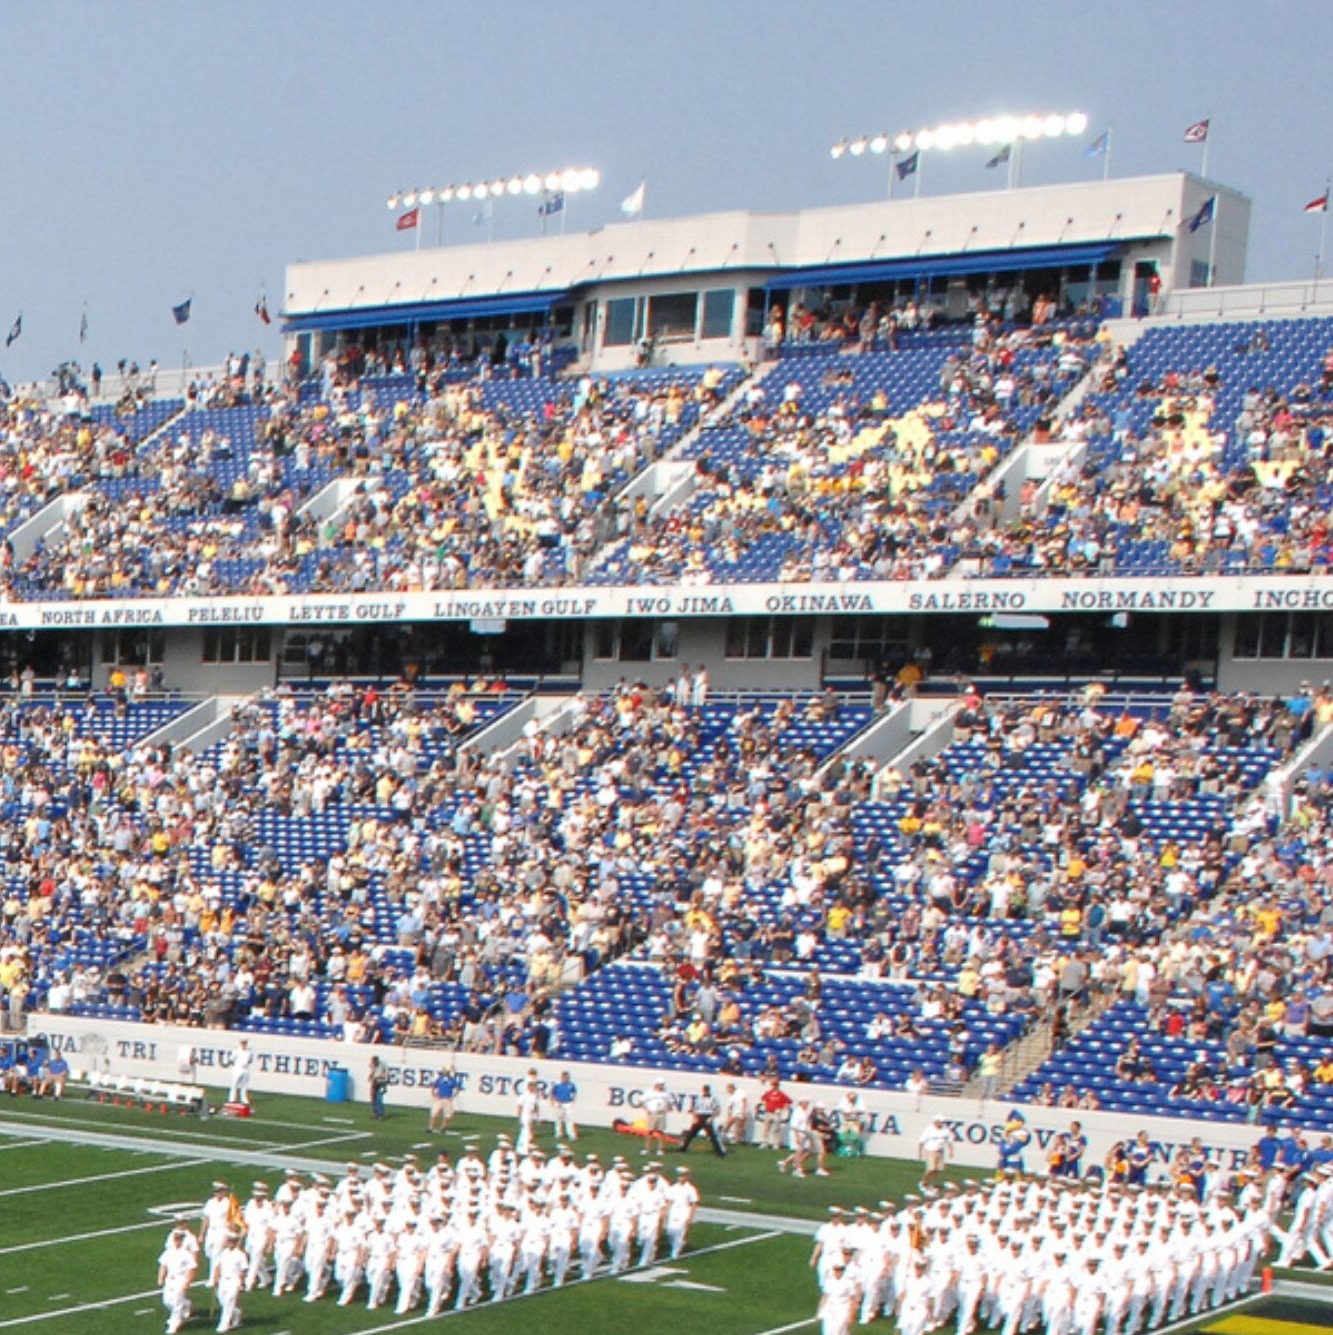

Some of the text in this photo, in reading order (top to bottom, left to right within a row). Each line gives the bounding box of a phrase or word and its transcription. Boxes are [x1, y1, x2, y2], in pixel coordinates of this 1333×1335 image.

[626, 597, 734, 614] IWO JIMA
[765, 595, 875, 612] OKINAWA
[908, 593, 1026, 609] SALERNO
[1061, 591, 1214, 609] NORMANDY
[41, 609, 163, 625] NORTH AFRICA
[187, 606, 264, 622] PELELIU
[289, 603, 406, 620] LEYTE GULF
[434, 600, 597, 618] LINGAYEN GULF
[117, 1040, 157, 1060] TRI
